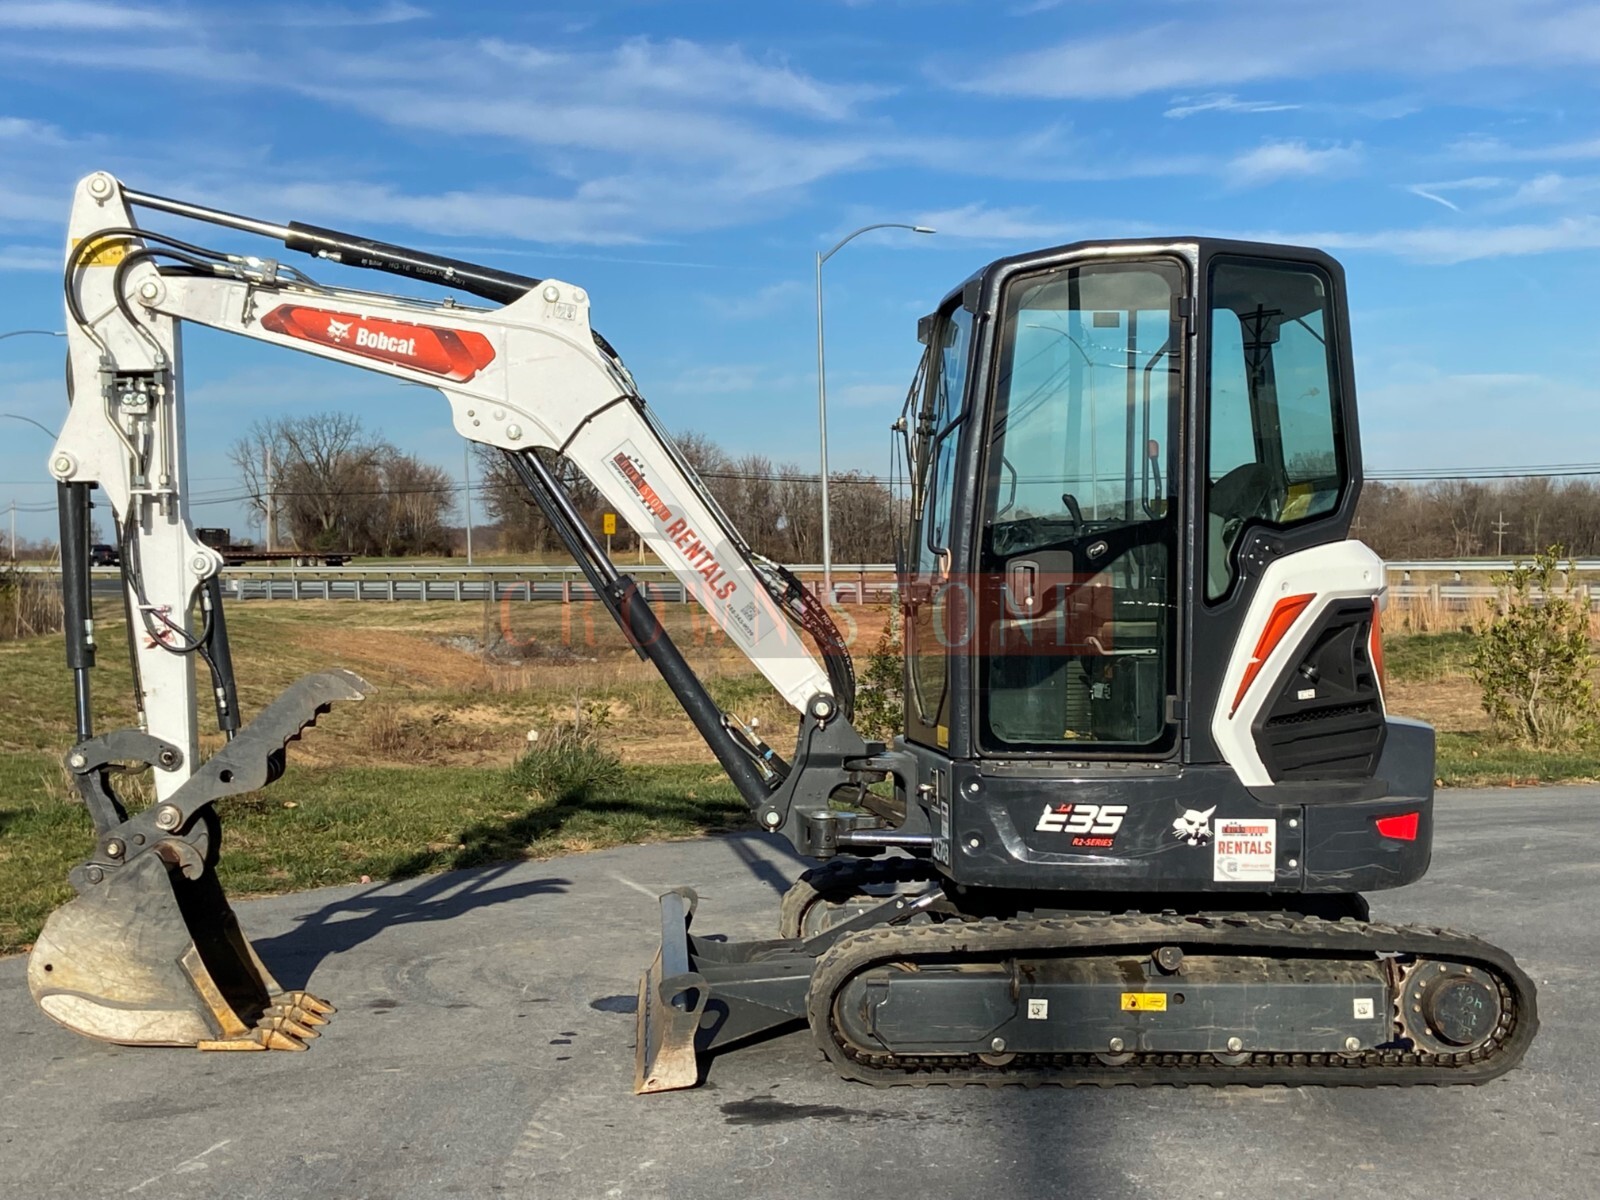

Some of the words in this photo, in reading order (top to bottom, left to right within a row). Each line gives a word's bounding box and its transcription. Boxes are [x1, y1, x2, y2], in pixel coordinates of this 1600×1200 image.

[356, 327, 416, 356] Bobcat
[665, 517, 738, 600] RENTALS
[1035, 803, 1128, 835] E35
[1072, 837, 1114, 848] R2-SERIES
[1217, 840, 1272, 855] RENTALS
